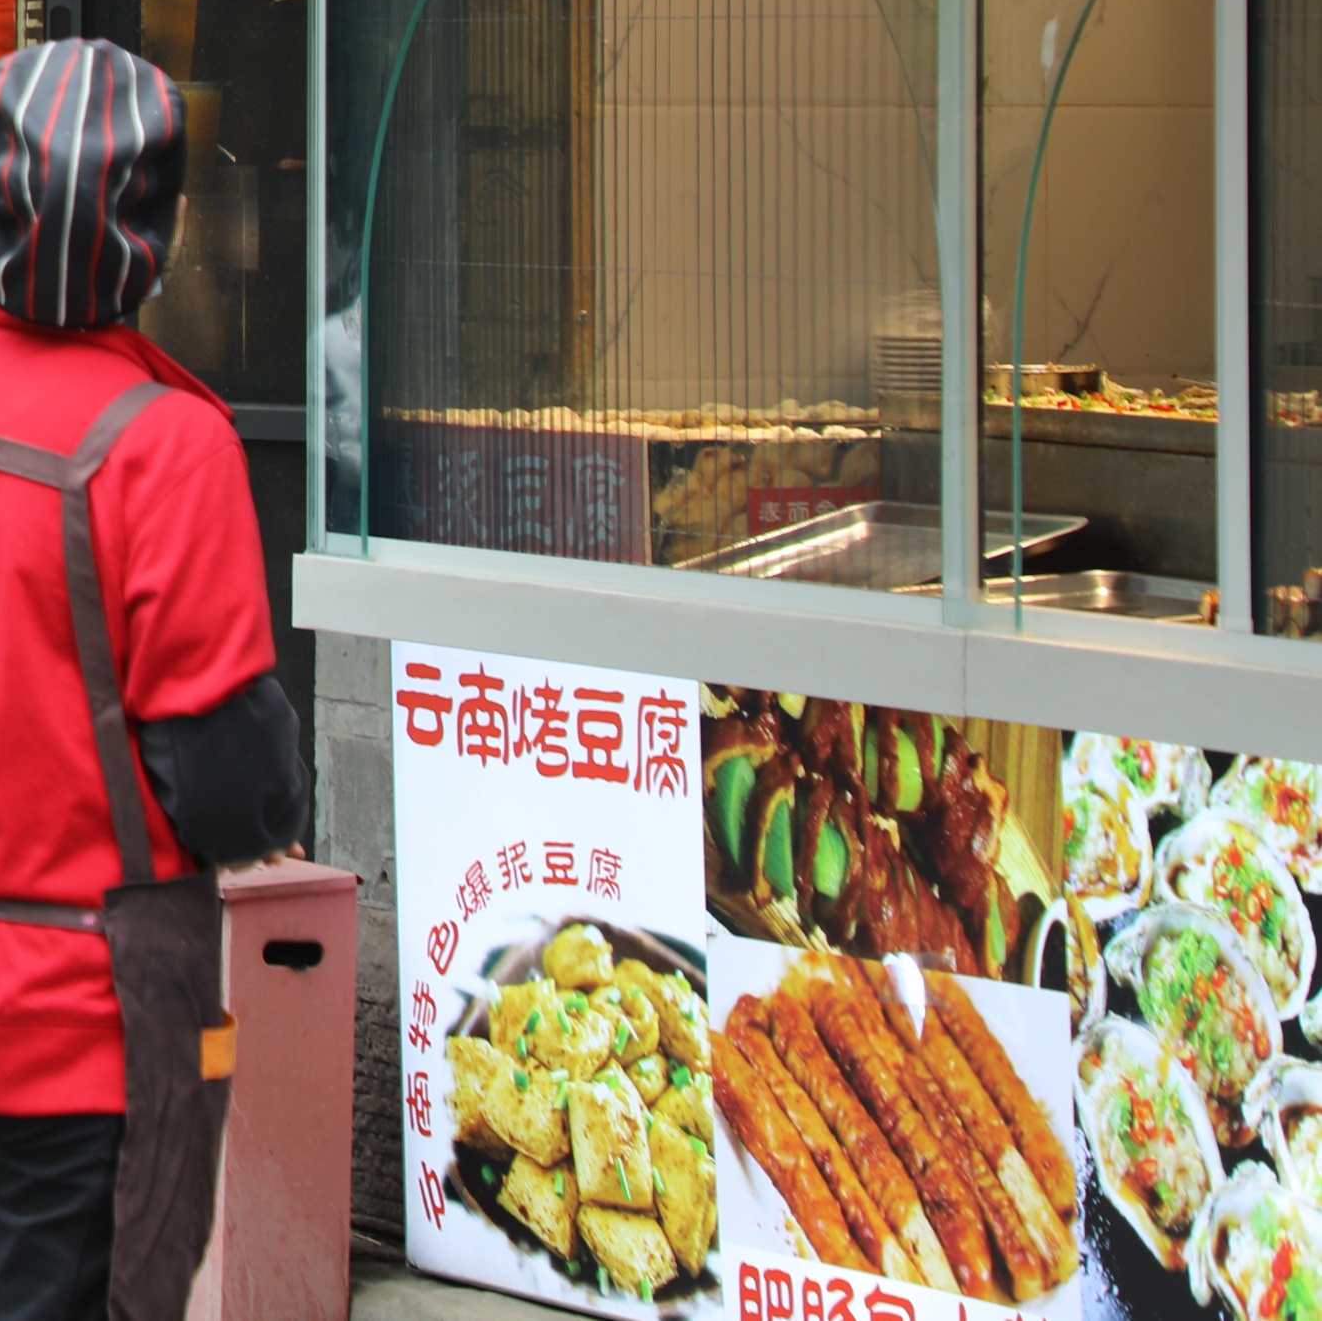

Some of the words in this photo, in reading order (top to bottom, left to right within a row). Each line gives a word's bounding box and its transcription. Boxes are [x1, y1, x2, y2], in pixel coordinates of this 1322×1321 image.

[395, 661, 690, 800] 云南烤豆腐
